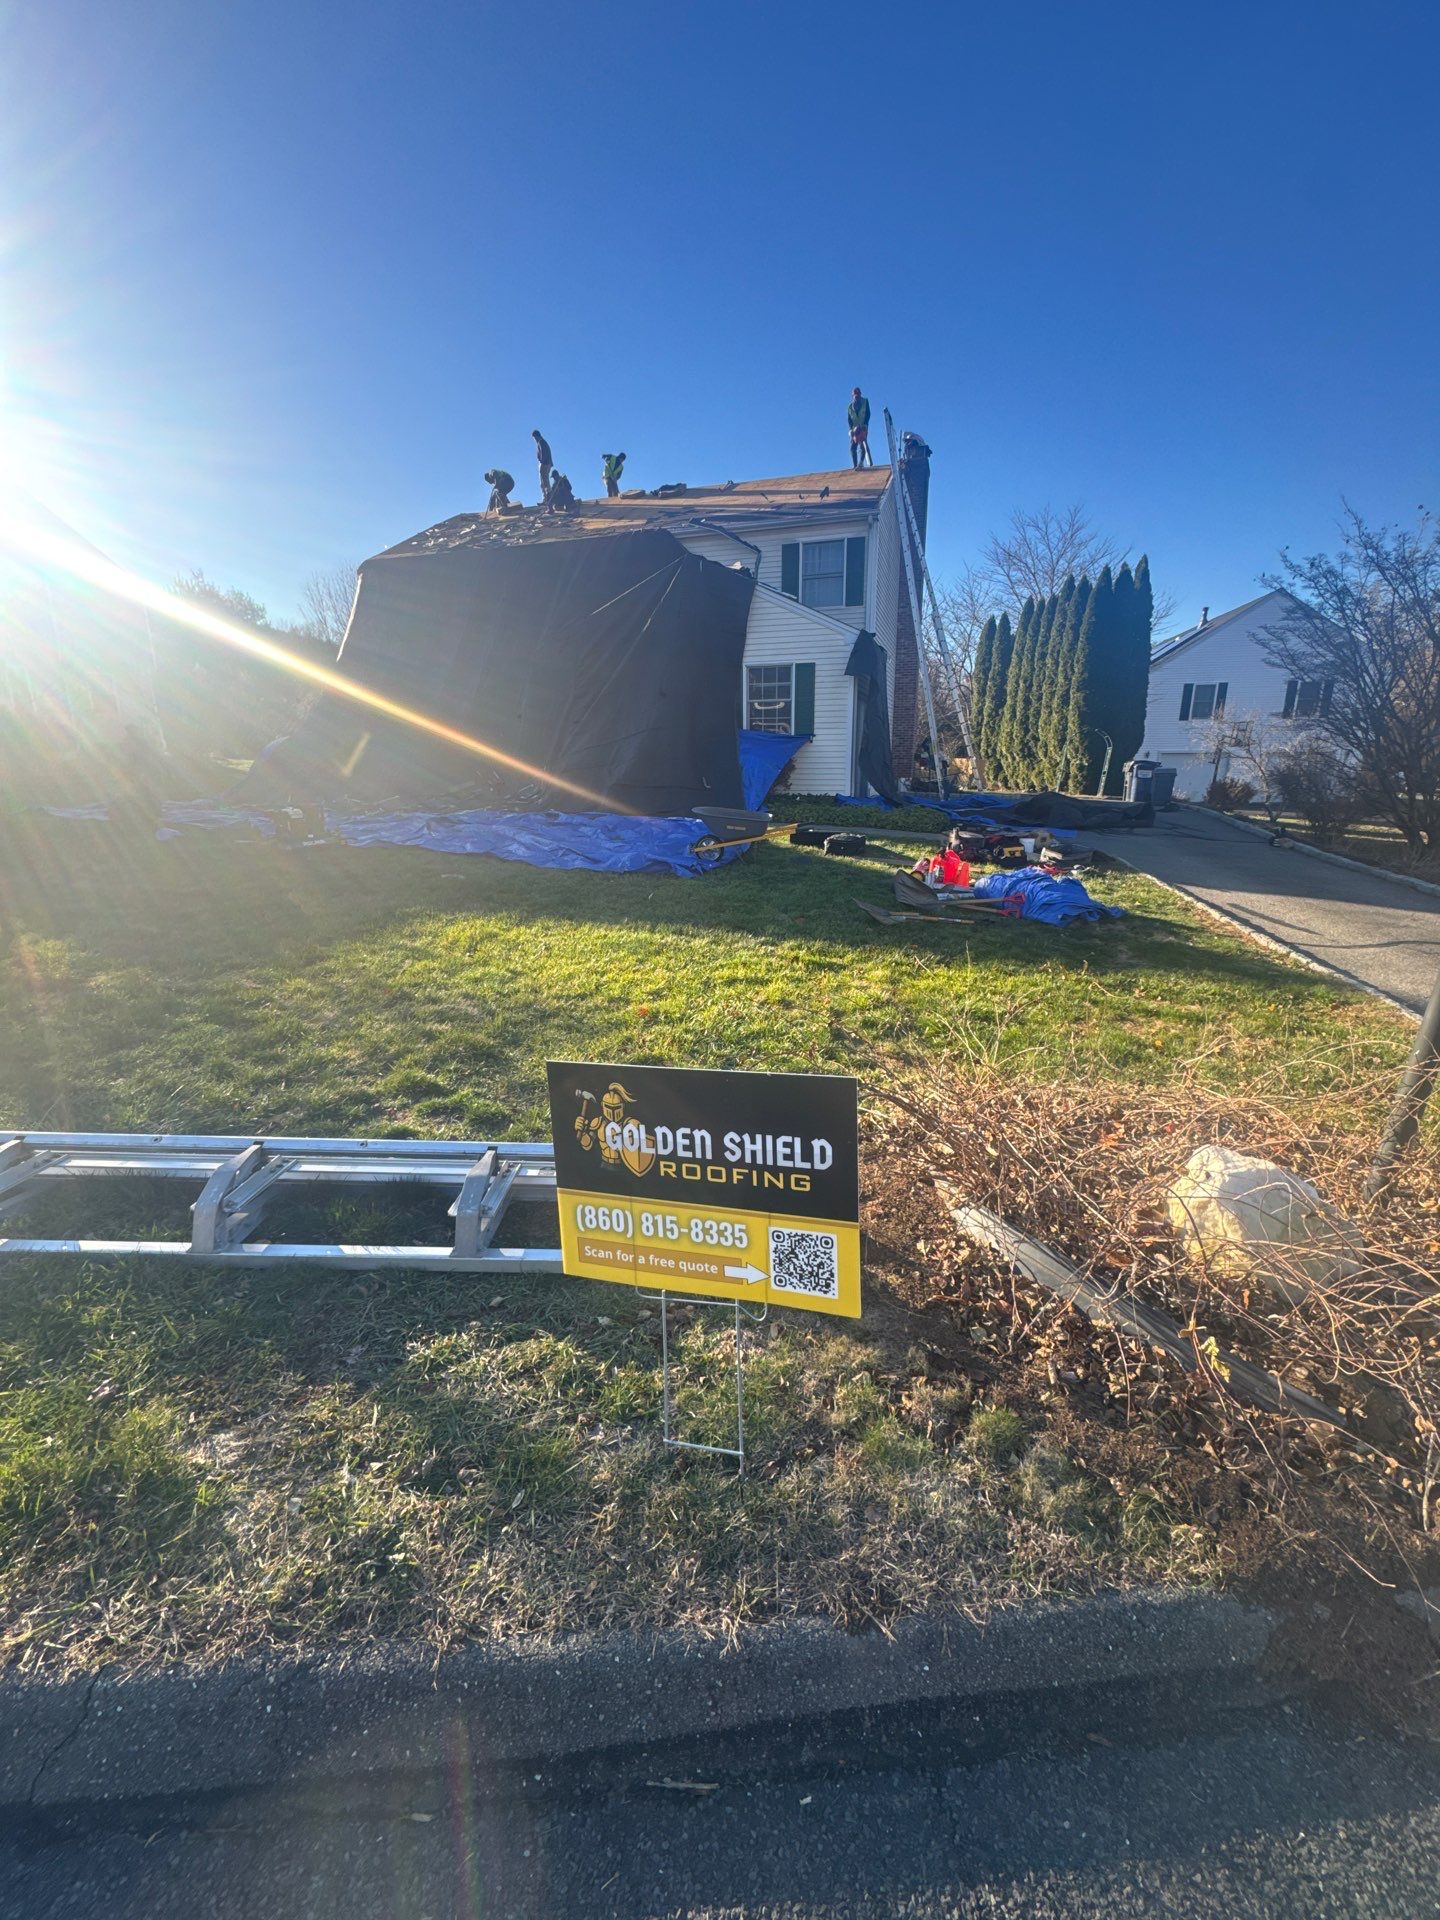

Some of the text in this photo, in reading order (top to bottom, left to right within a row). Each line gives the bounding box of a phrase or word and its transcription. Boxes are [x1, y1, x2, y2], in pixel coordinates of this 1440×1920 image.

[605, 1121, 833, 1170] GOLDEN SHIELD
[659, 1160, 811, 1192] ROOFING
[576, 1204, 748, 1249] (860) 815-8335
[584, 1245, 718, 1274] Scan for a free quote
